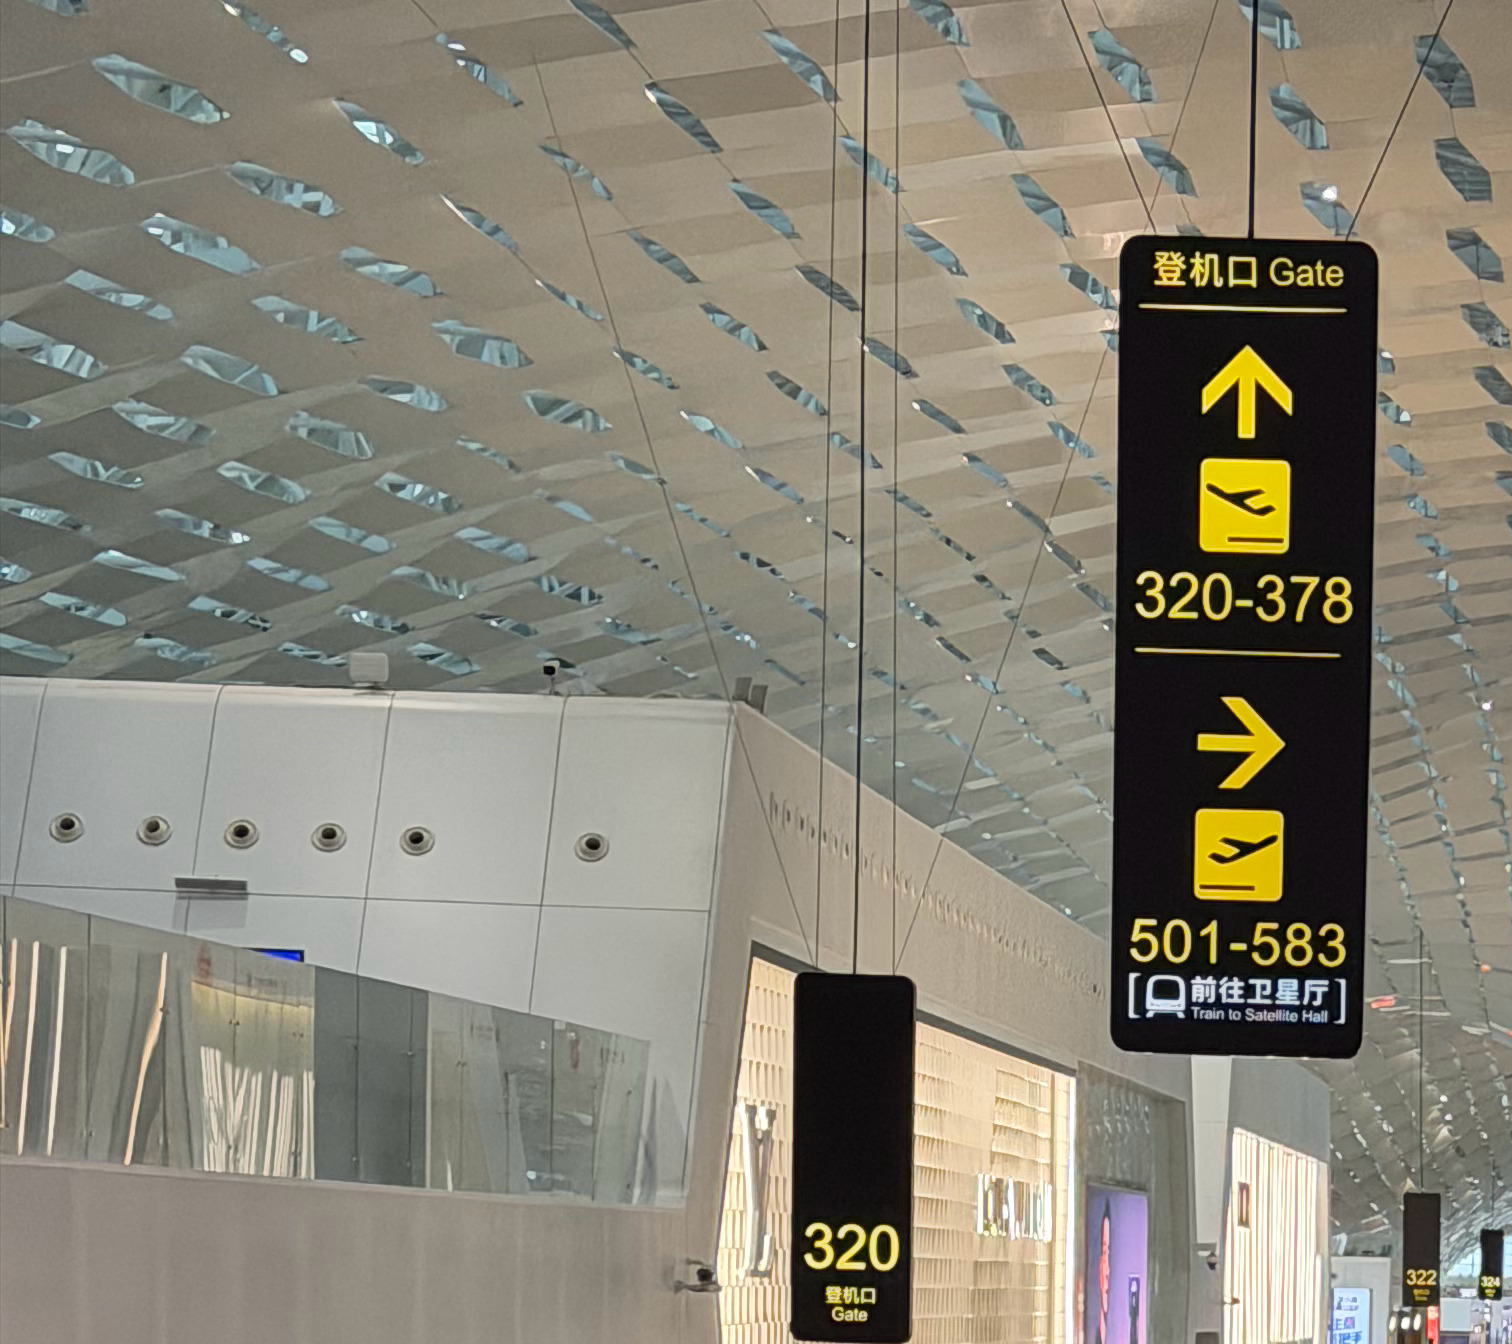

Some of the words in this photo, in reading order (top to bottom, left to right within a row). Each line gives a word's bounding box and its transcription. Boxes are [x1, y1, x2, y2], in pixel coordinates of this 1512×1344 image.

[1153, 251, 1257, 288] 登机口
[1269, 258, 1345, 287] Gate
[1135, 571, 1354, 624] 320-378
[1129, 918, 1347, 967] 501-583
[1190, 976, 1330, 1006] 前往卫星厅
[1190, 1007, 1225, 1021] Train
[1228, 1007, 1242, 1021] to
[1244, 1008, 1299, 1023] Satellite
[1302, 1009, 1329, 1024] Hall
[803, 1222, 900, 1272] 320
[1406, 1269, 1437, 1286] 322
[825, 1285, 877, 1305] 登机口
[831, 1306, 869, 1322] Gate
